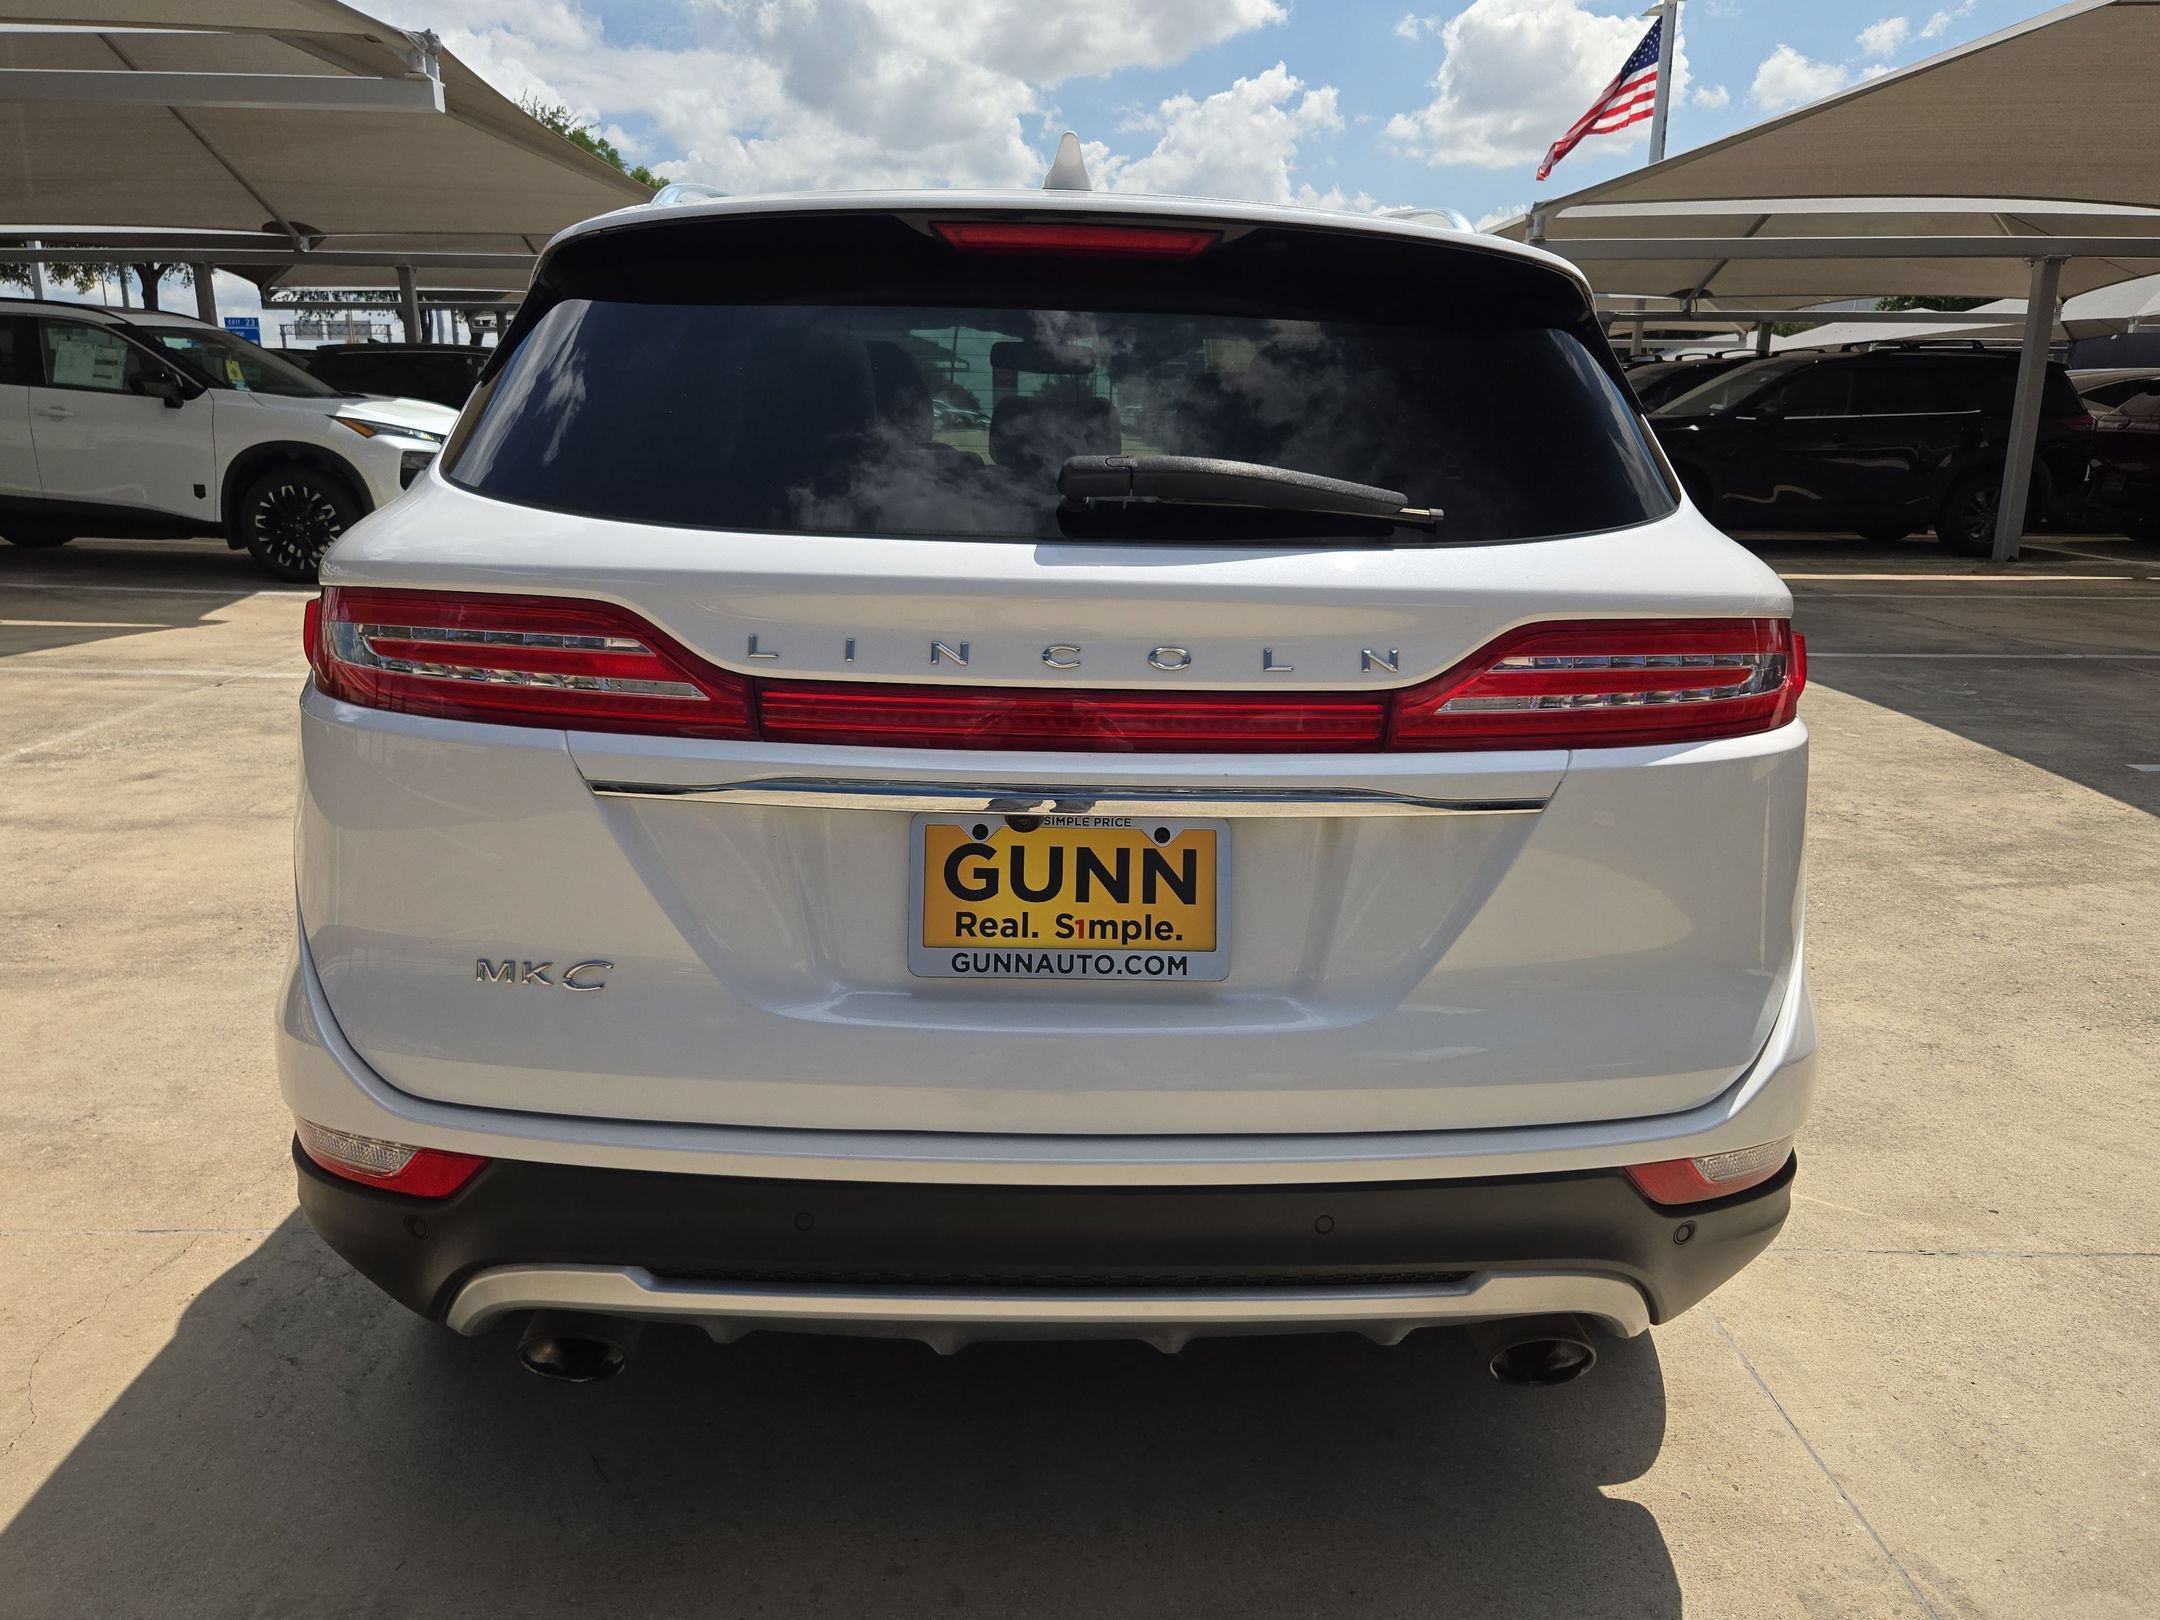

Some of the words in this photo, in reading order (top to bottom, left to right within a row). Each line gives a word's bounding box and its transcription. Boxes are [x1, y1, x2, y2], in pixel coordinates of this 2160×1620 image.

[748, 633, 1399, 673] LINCOLN
[1043, 816, 1090, 827] SIMPLE
[1094, 817, 1132, 827] PRICE
[944, 842, 1197, 905] GUNN
[955, 911, 1039, 939] Real.
[476, 958, 614, 991] MKC
[951, 953, 1188, 976] GUNNAUTO.COM
